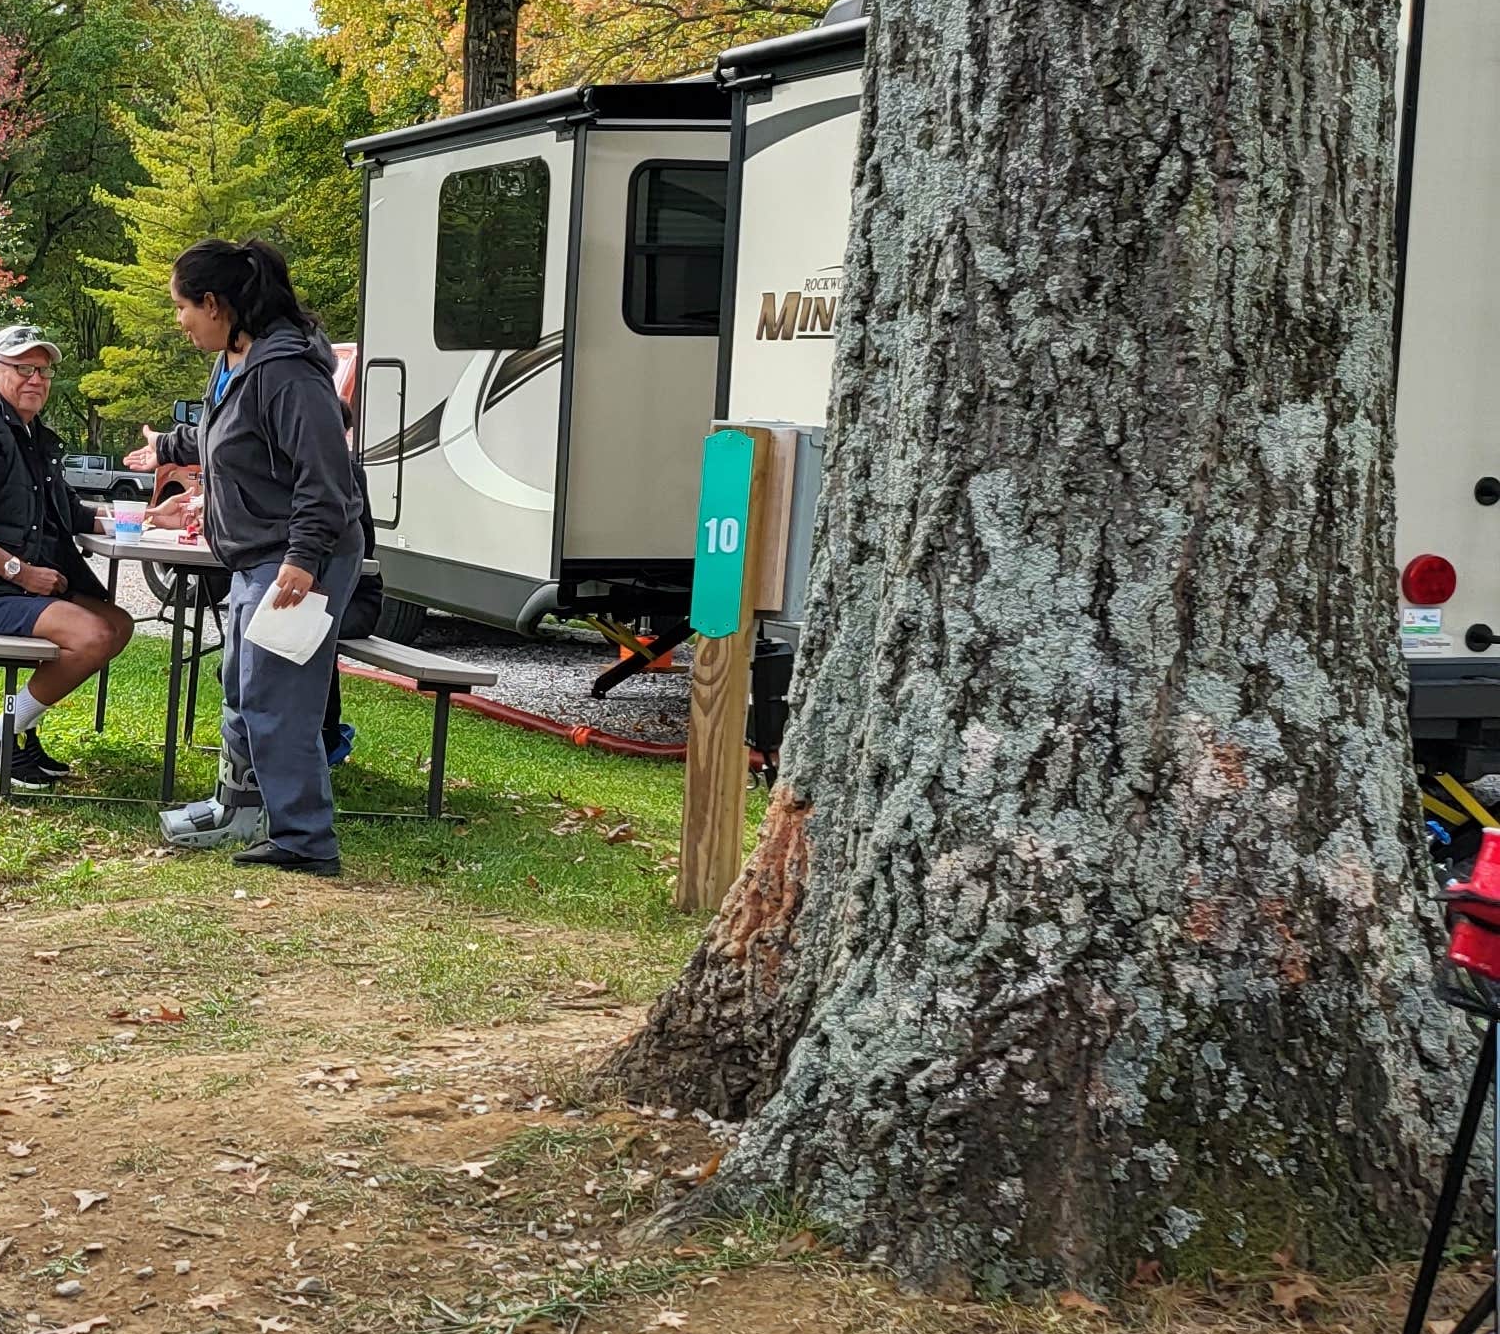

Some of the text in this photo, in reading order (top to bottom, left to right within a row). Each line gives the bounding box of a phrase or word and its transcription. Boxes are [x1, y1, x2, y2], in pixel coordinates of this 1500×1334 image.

[756, 291, 842, 341] MIN
[704, 517, 739, 553] 10
[7, 695, 14, 713] 8
